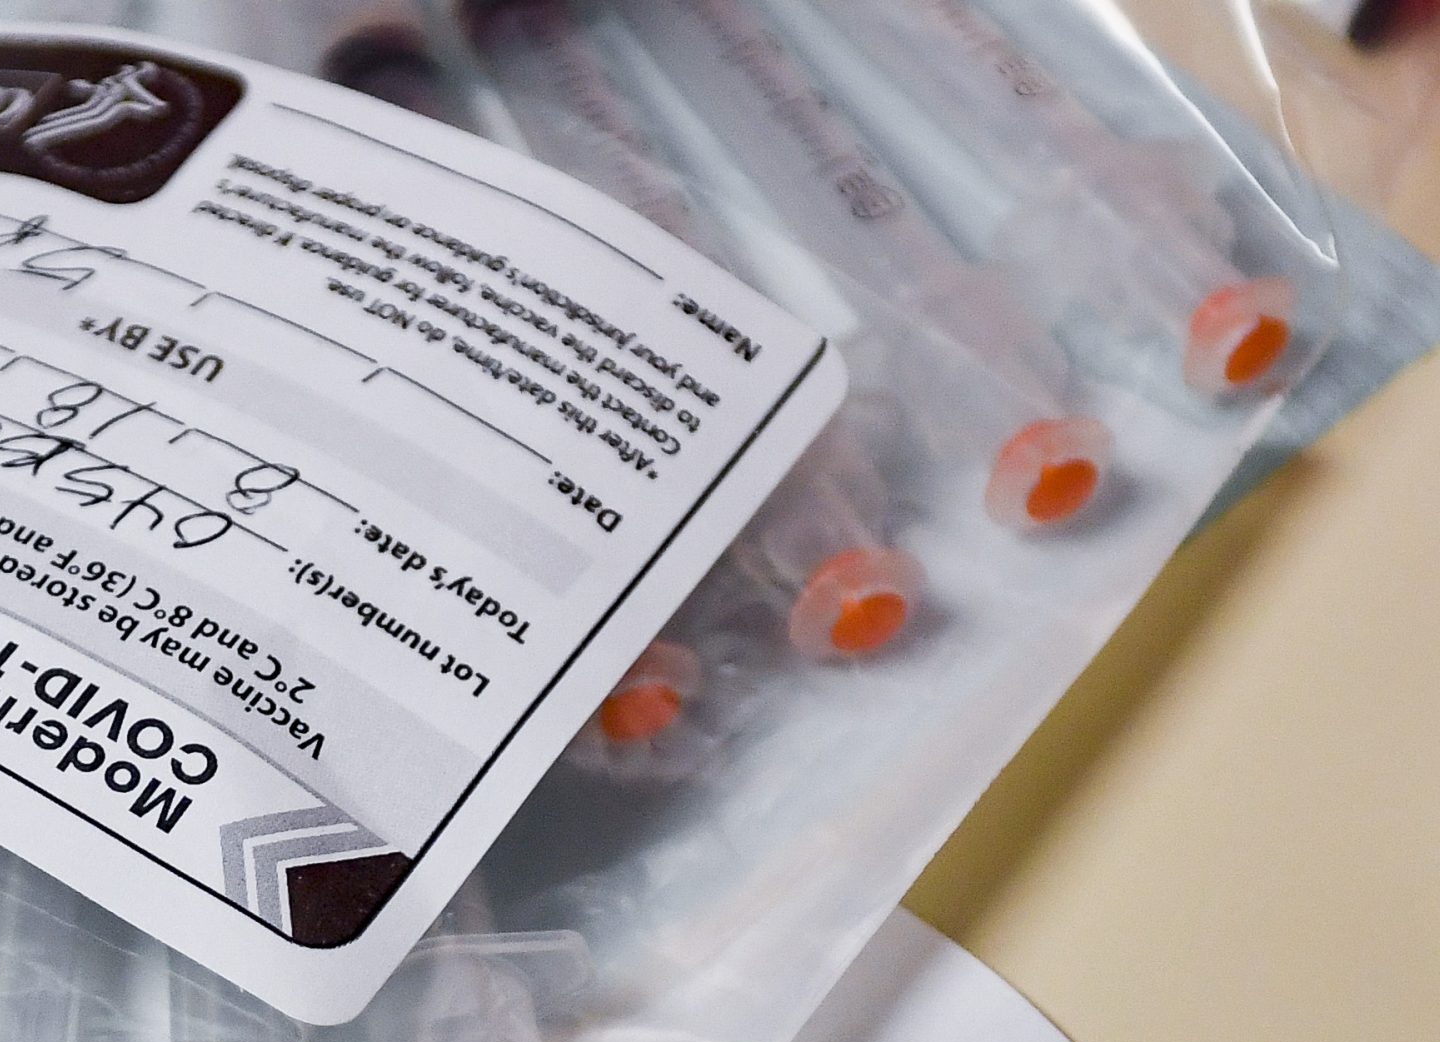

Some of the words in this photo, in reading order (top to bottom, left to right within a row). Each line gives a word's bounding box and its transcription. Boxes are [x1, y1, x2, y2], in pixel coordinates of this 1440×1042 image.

[371, 237, 406, 261] the
[411, 223, 508, 273] guidance
[392, 281, 426, 303] for
[407, 254, 471, 294] follow
[362, 300, 415, 330] NOT
[416, 320, 447, 343] do
[424, 294, 567, 377] manufacturer
[672, 293, 762, 363] Name:
[147, 335, 225, 383] USE
[561, 333, 598, 364] the
[629, 343, 683, 380] your
[565, 370, 602, 402] the
[594, 357, 676, 413] discard
[675, 374, 721, 408] and
[557, 401, 598, 435] this
[600, 393, 682, 457] Contact
[676, 409, 701, 434] to
[547, 471, 623, 534] Date:
[354, 519, 427, 572] date:
[97, 604, 141, 642] be
[288, 558, 441, 661] number(s):
[428, 566, 531, 645] Today's
[138, 627, 212, 673] may
[189, 617, 259, 661] and
[440, 654, 491, 698] Lot
[212, 665, 325, 761] Vaccine
